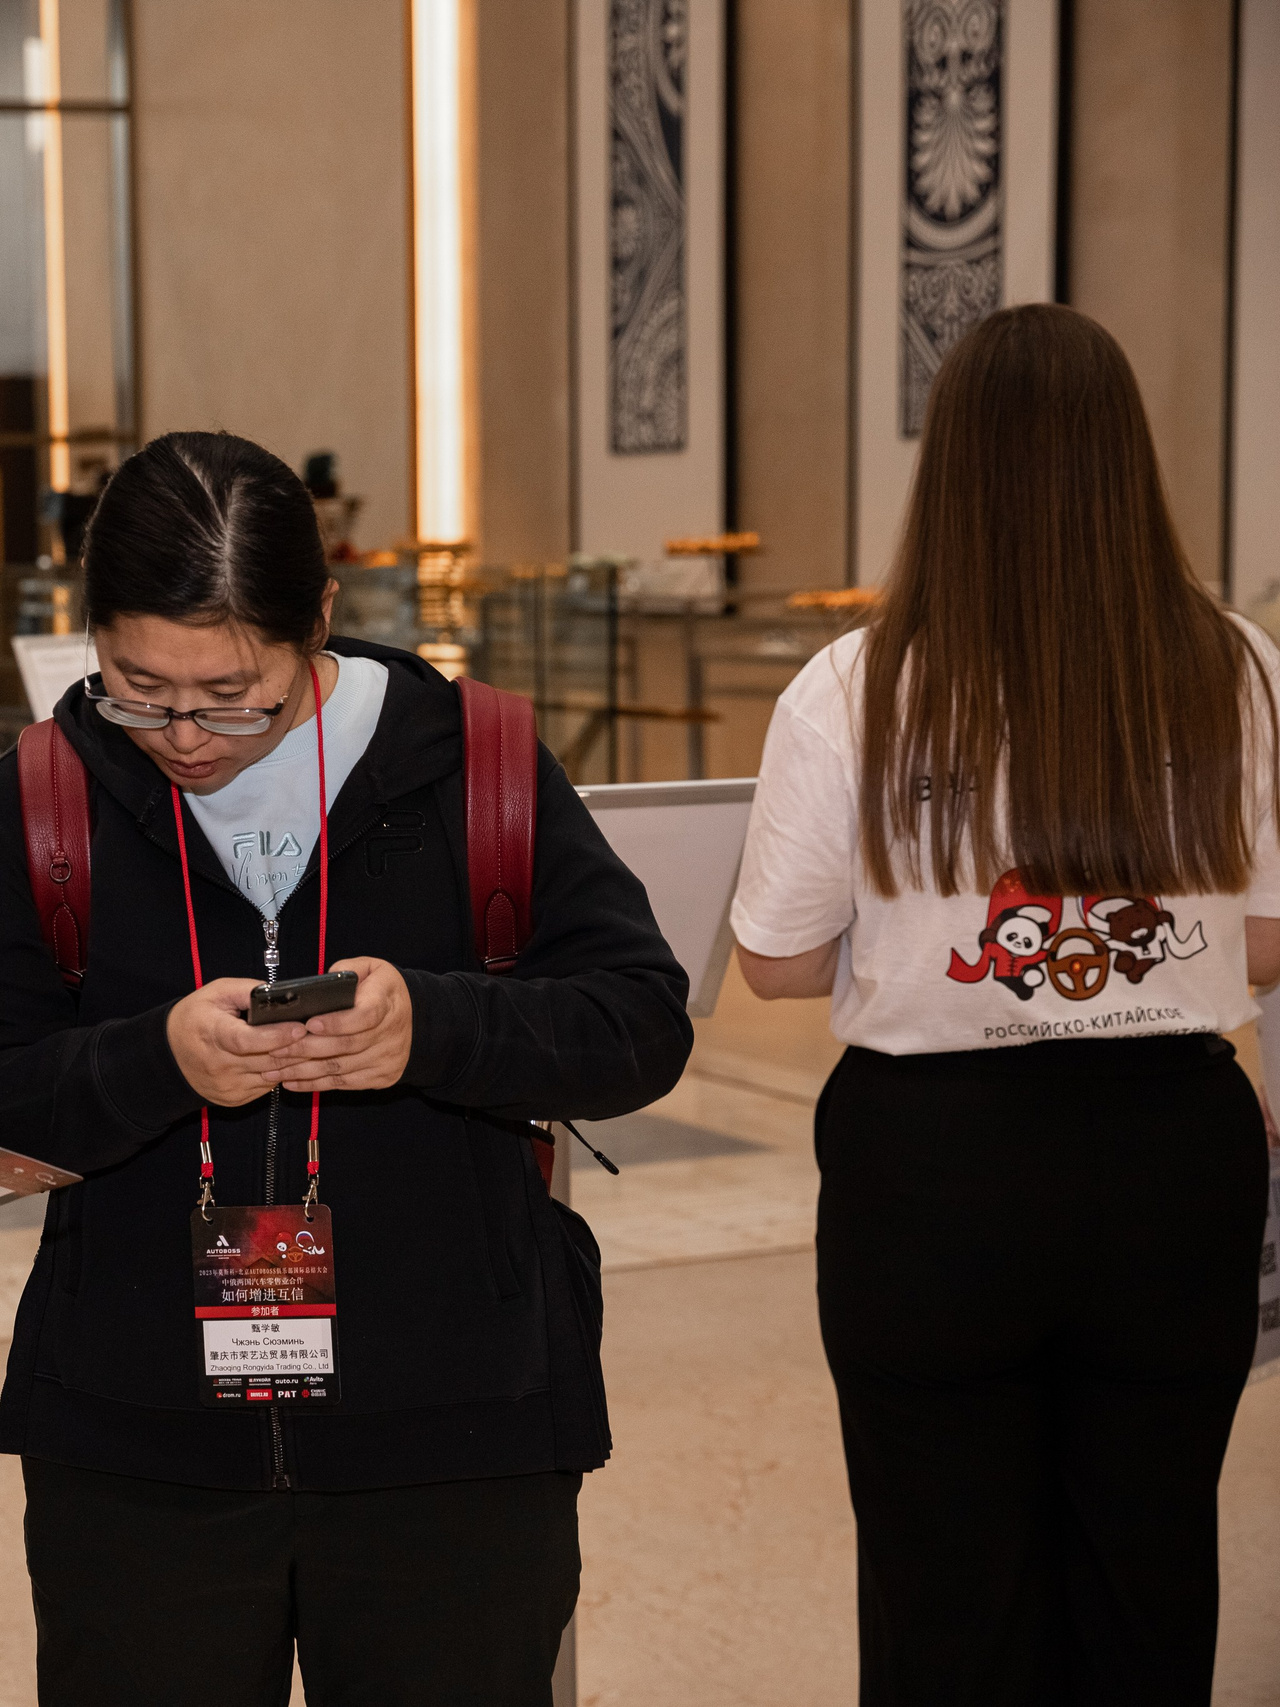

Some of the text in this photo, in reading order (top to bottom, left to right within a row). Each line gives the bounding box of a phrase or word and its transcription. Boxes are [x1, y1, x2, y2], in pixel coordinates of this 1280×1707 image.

[232, 830, 303, 859] FILA
[983, 1006, 1185, 1040] РОССИЙСКО-КИТАЙСКОЕ
[221, 1287, 304, 1303] 如何增进互信
[251, 1305, 280, 1316] 参加者
[231, 1336, 305, 1346] Чжэнь Сюэминь
[209, 1348, 329, 1361] 肇庆市荣艺达贸易有限公司
[210, 1364, 242, 1373] Zhaoqing
[242, 1363, 275, 1372] Rongyida
[276, 1363, 302, 1371] Trading
[318, 1362, 330, 1370] Ltd
